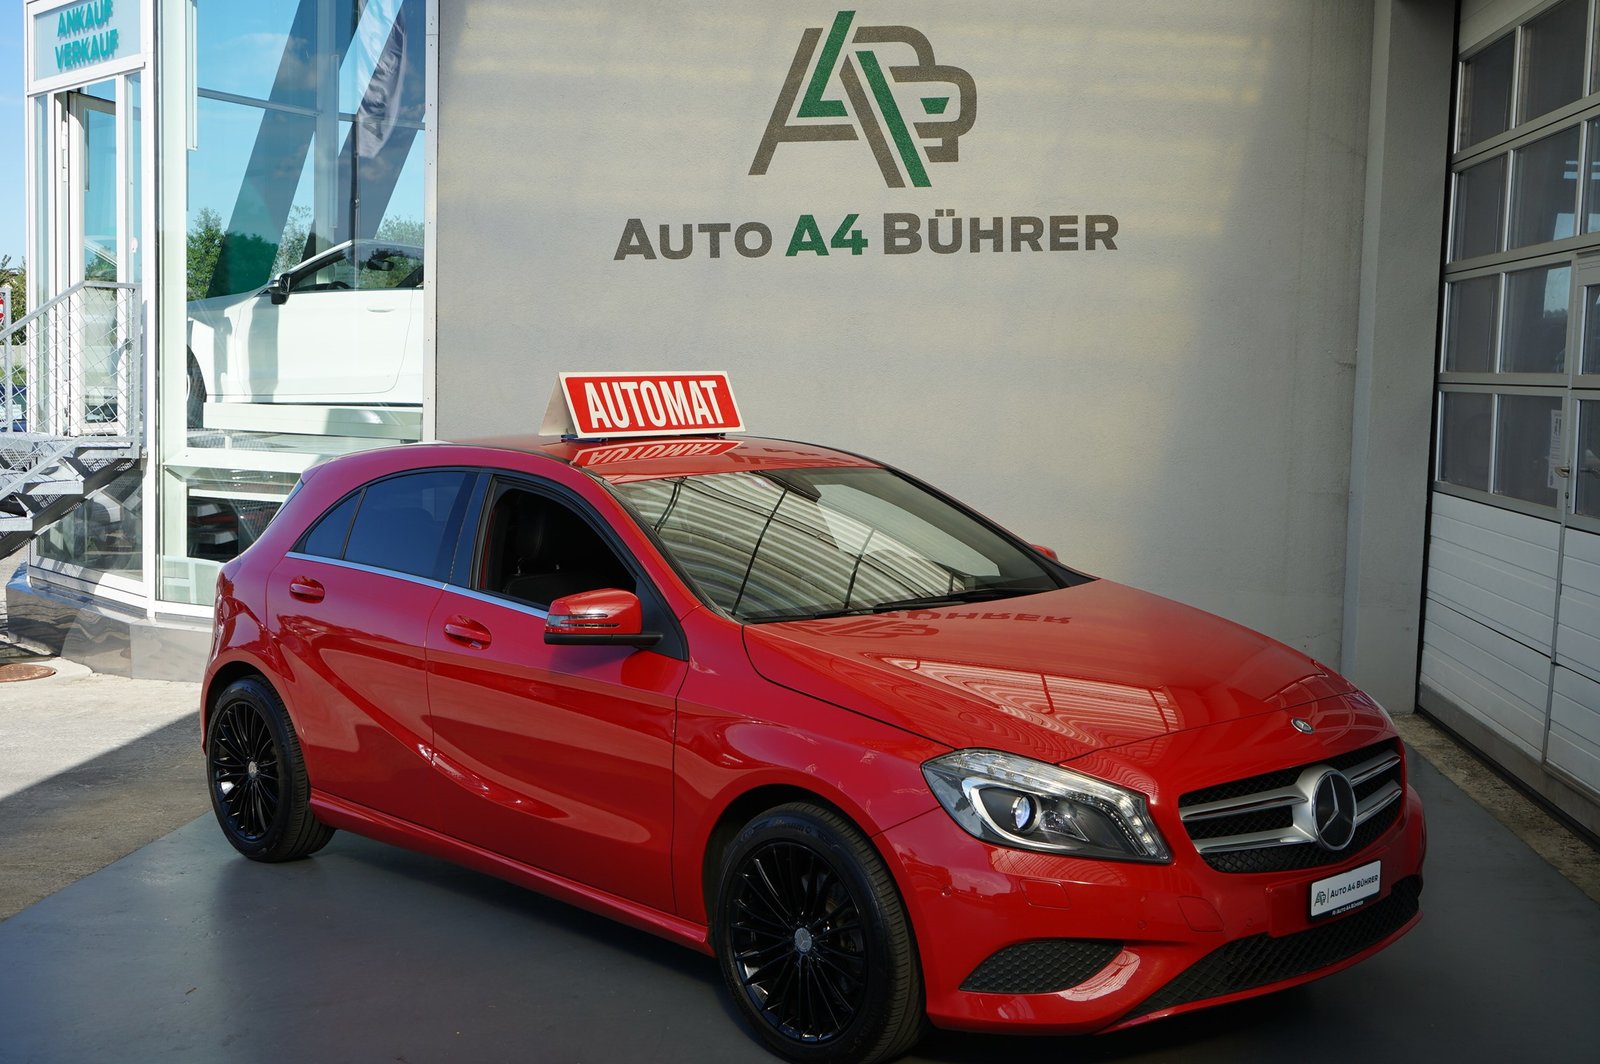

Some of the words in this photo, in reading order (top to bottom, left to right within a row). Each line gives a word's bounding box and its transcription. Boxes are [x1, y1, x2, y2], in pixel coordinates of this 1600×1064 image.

[57, 0, 112, 38] ANKAUF
[54, 28, 118, 70] VERKAUF
[613, 217, 773, 261] AUTO
[785, 213, 869, 257] A4
[883, 208, 1119, 256] BÜHRER
[584, 380, 724, 429] AUTOMAT
[1330, 887, 1347, 898] AUTO
[1347, 883, 1356, 892] A4
[1356, 874, 1379, 889] BÜHRER
